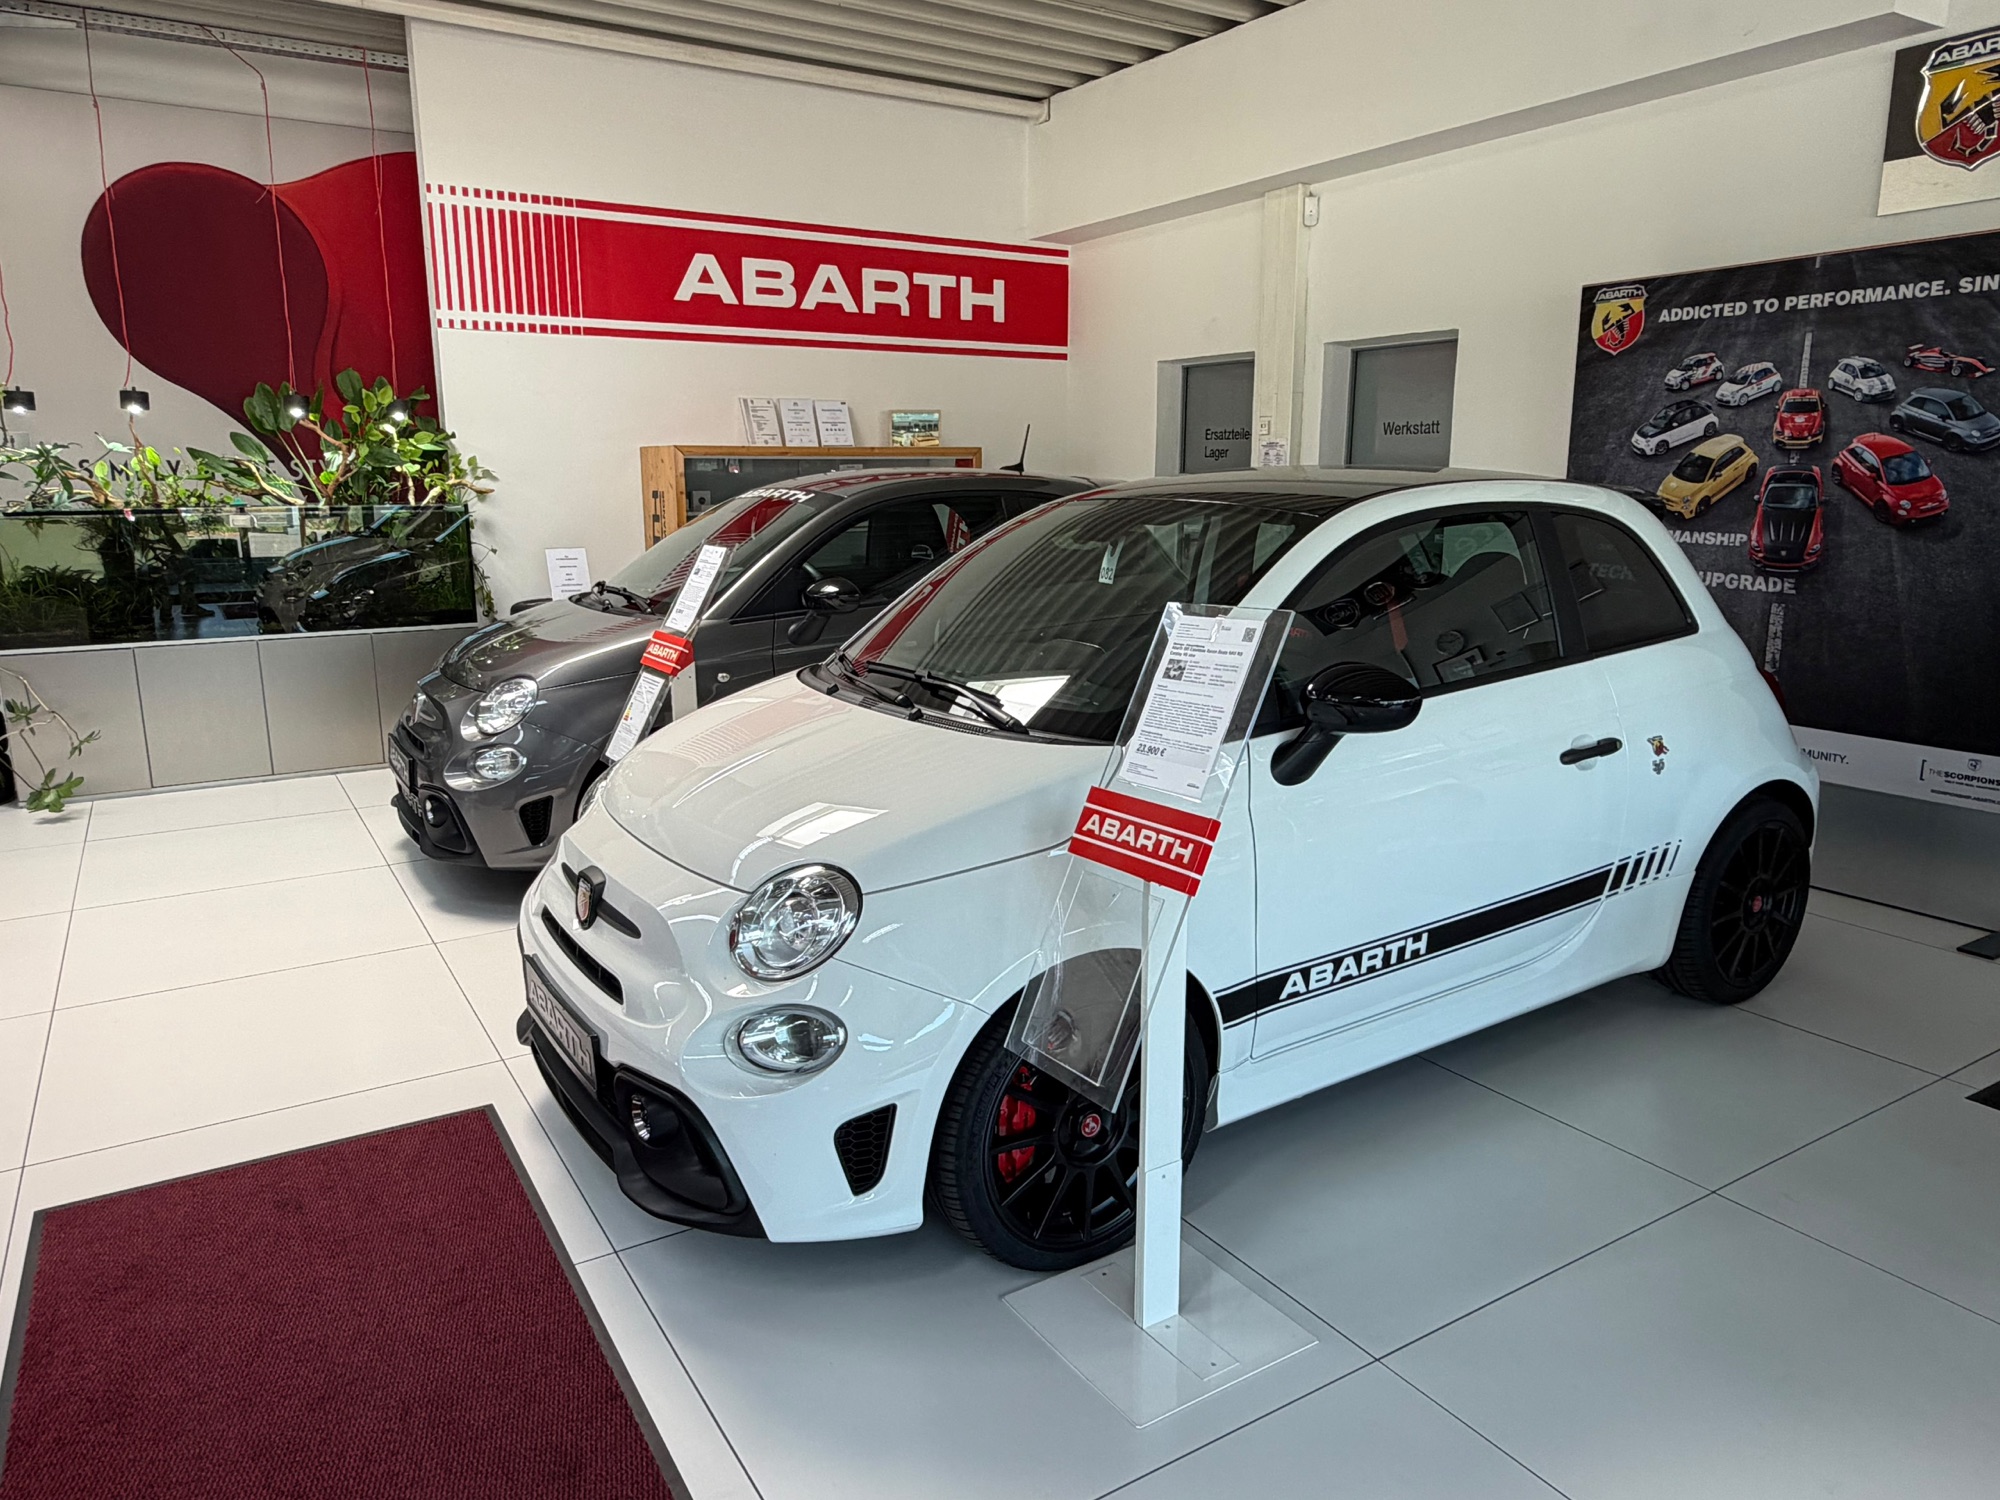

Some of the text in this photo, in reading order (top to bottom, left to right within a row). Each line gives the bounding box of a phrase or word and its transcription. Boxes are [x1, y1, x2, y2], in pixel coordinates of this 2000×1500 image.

[674, 252, 1005, 323] ABARTH
[1598, 288, 1642, 300] ABARTH
[1658, 273, 2000, 323] ADDICTED TO PERFORMANCE. SIN
[1382, 420, 1441, 436] Werkstatt
[1204, 446, 1229, 460] Lager
[645, 643, 679, 662] ABARTH
[1136, 742, 1159, 757] 23.900
[1081, 813, 1194, 864] ABARTH
[1279, 932, 1429, 1001] ABARTH
